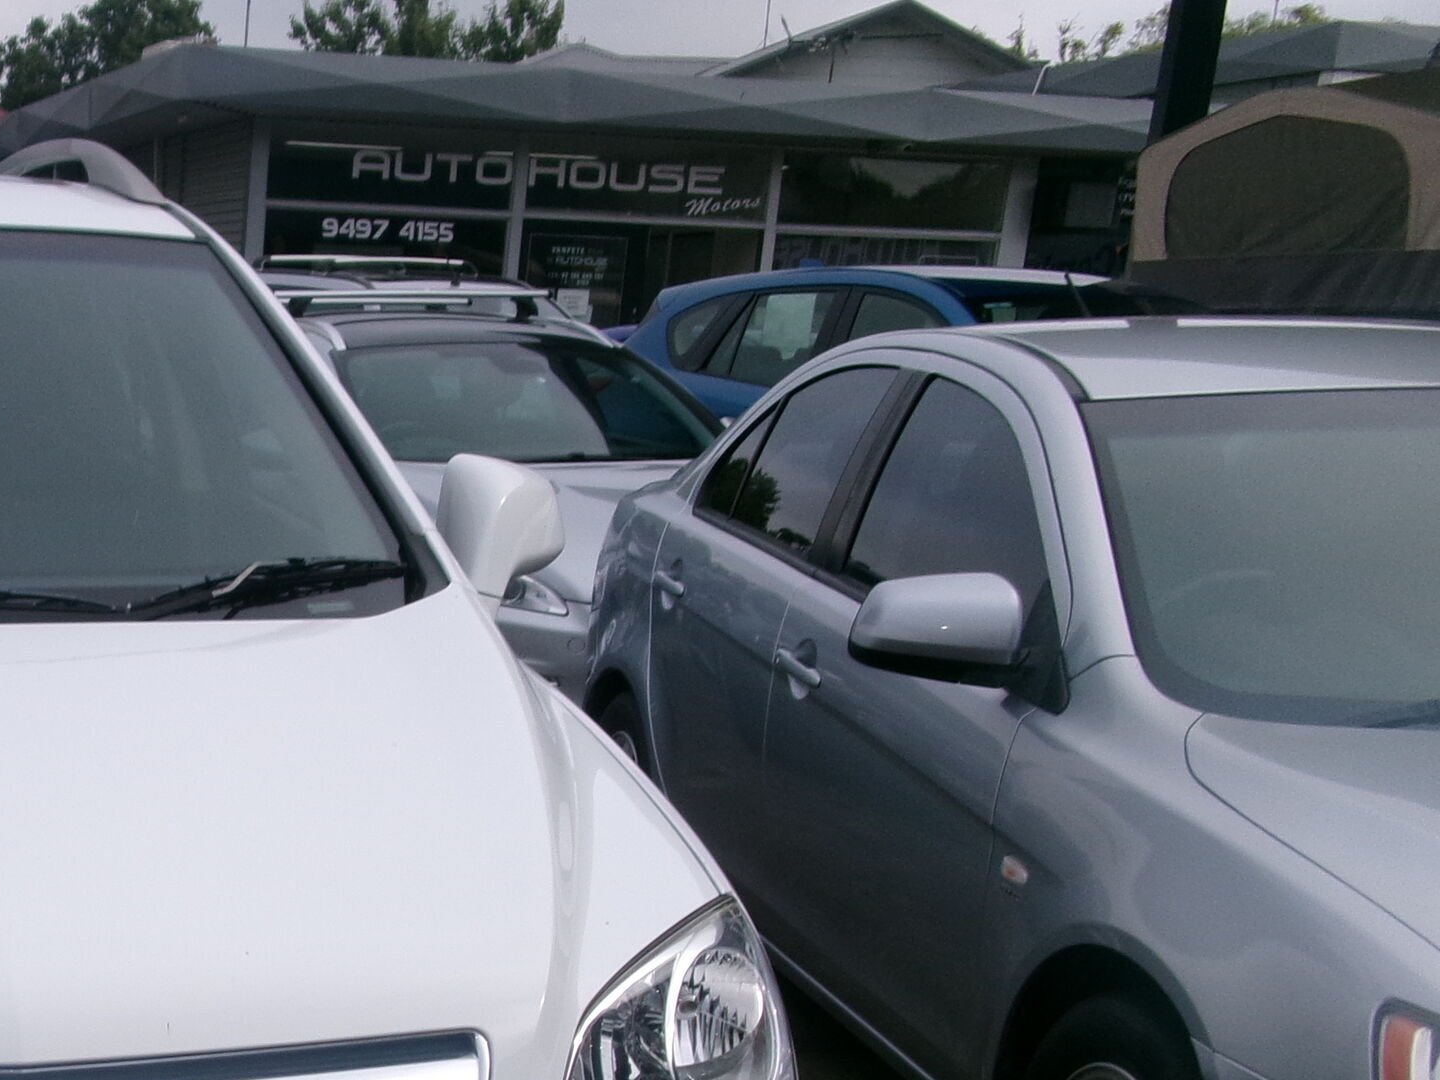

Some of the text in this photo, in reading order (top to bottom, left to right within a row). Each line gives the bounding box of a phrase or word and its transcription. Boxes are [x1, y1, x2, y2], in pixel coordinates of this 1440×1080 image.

[685, 197, 760, 217] Motors
[322, 217, 454, 242] 9497 4155
